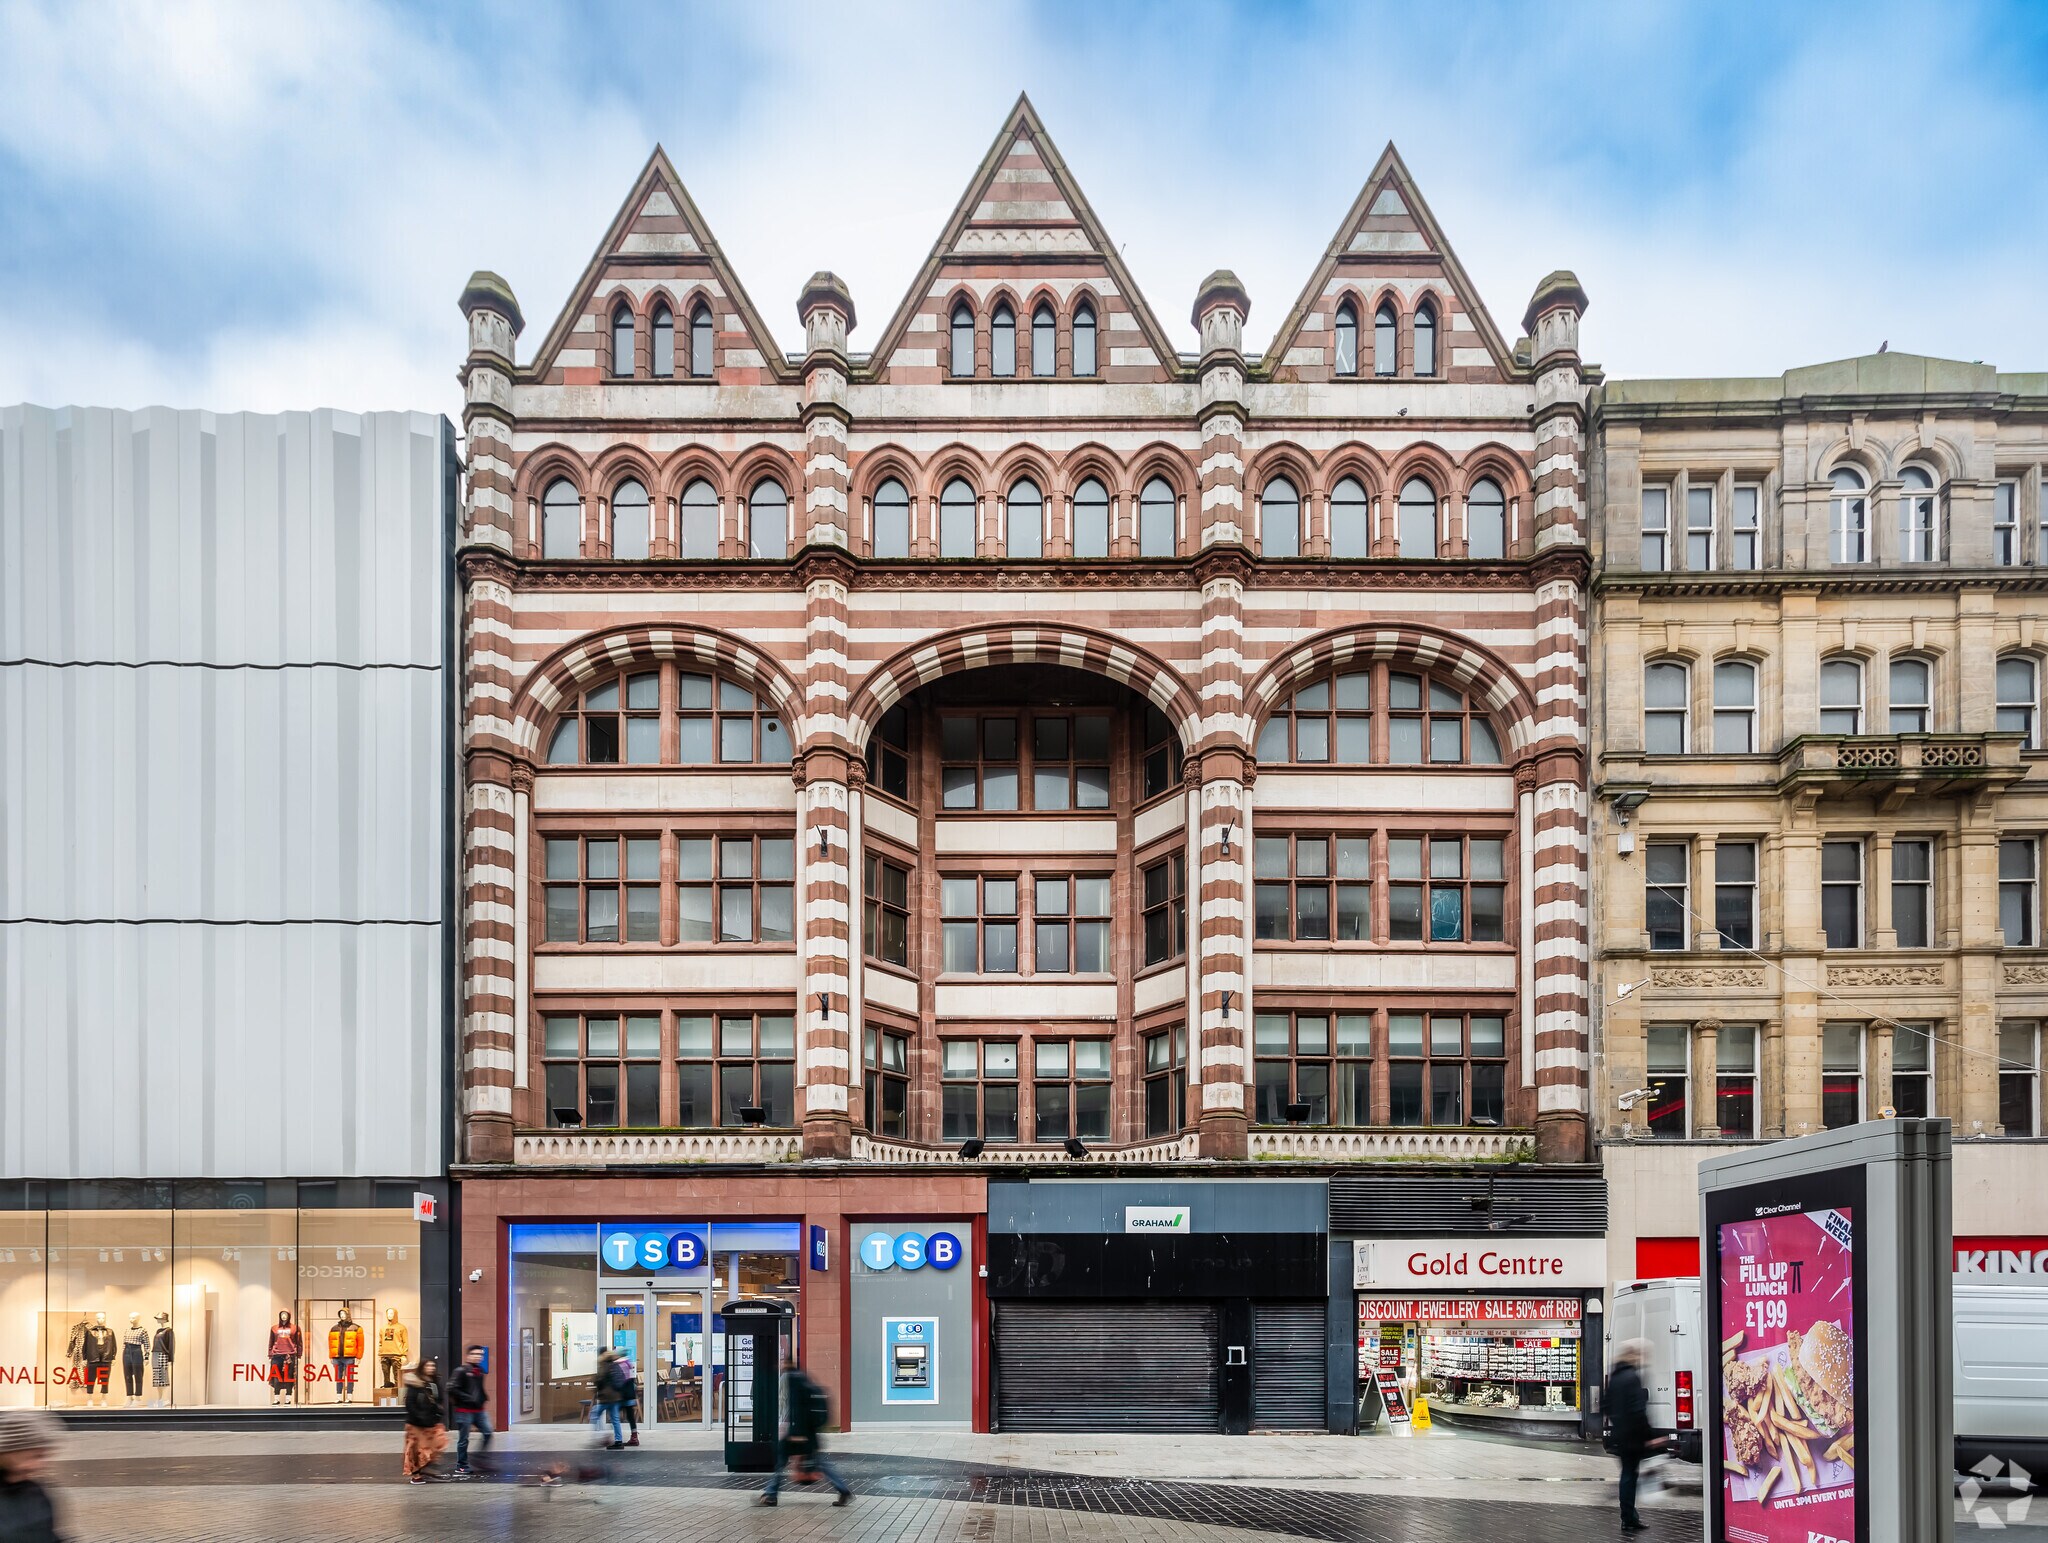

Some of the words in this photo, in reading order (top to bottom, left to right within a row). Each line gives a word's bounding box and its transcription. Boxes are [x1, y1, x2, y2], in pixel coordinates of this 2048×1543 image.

[420, 1199, 433, 1215] H&M
[1763, 1206, 1777, 1215] Clear
[1778, 1202, 1801, 1212] Channel
[1132, 1219, 1173, 1227] GRAHAM
[1825, 1220, 1851, 1246] WEEK
[611, 1237, 697, 1264] TSB
[868, 1237, 956, 1264] TSB
[1740, 1255, 1754, 1264] THE
[1407, 1252, 1468, 1275] Gold
[1478, 1252, 1563, 1275] Centre
[1740, 1264, 1766, 1282] FILL
[1769, 1262, 1788, 1280] UP
[1746, 1281, 1787, 1296] LUNCH
[1359, 1301, 1413, 1319] DISCOUNT
[1416, 1301, 1480, 1319] JEWELLERY
[1485, 1301, 1513, 1319] SALE
[1516, 1301, 1537, 1319] 50%
[1540, 1300, 1553, 1318] off
[1556, 1301, 1578, 1318] RRP
[1746, 1300, 1787, 1337] £1.99
[0, 1366, 45, 1384] NAL
[52, 1366, 109, 1385] SALE
[233, 1364, 296, 1382] FINAL
[303, 1364, 359, 1382] SALE
[1774, 1498, 1795, 1509] UNTIL
[1796, 1496, 1812, 1506] 3PM
[1812, 1491, 1837, 1503] EVERY
[1838, 1488, 1854, 1499] DAY
